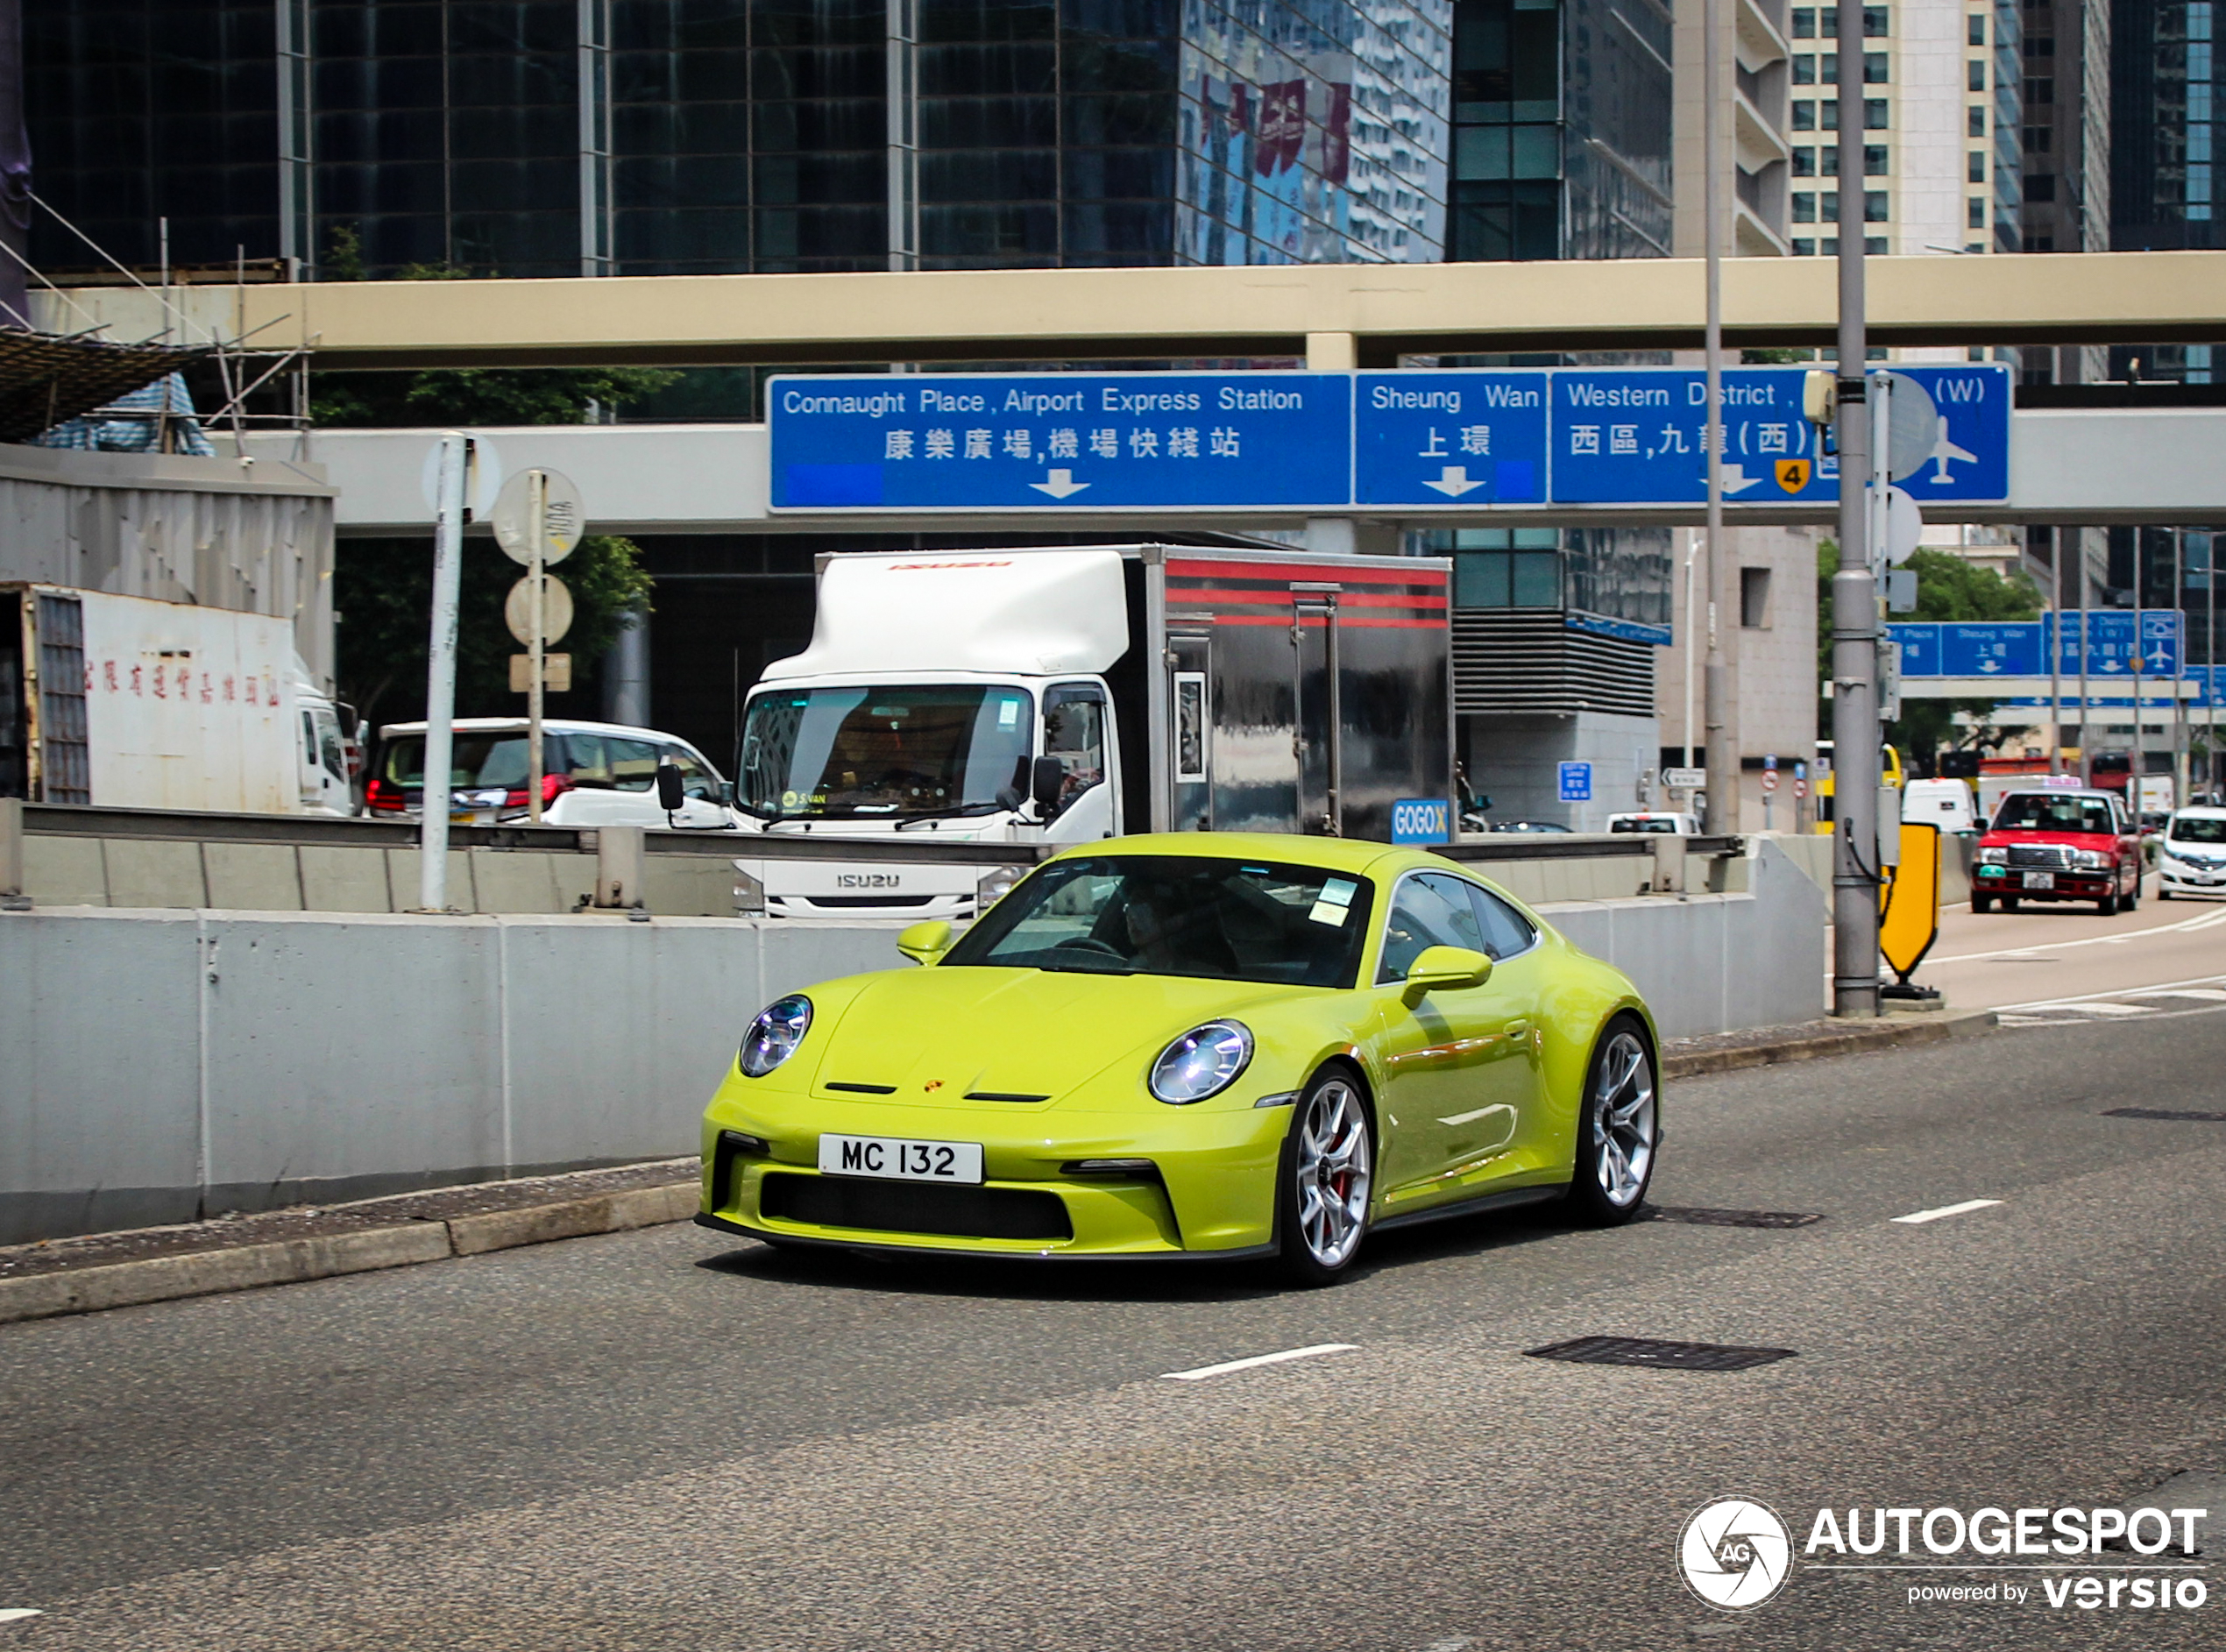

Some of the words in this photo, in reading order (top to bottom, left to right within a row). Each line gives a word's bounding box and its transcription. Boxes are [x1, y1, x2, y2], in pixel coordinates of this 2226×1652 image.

[783, 390, 906, 418] Connaught
[1003, 386, 1084, 416] Airport
[1102, 387, 1202, 415] Express
[1218, 386, 1303, 411] Station
[1371, 386, 1463, 413] Sheung
[1485, 385, 1541, 408] Wan
[1566, 382, 1670, 407] Western
[1935, 376, 1986, 404] (W)
[1419, 425, 1492, 457] 上環
[1783, 464, 1803, 486] 4
[1393, 805, 1448, 836] GOGOX
[838, 875, 900, 888] ISUZU
[842, 1141, 883, 1171] MC
[900, 1145, 955, 1176] 132
